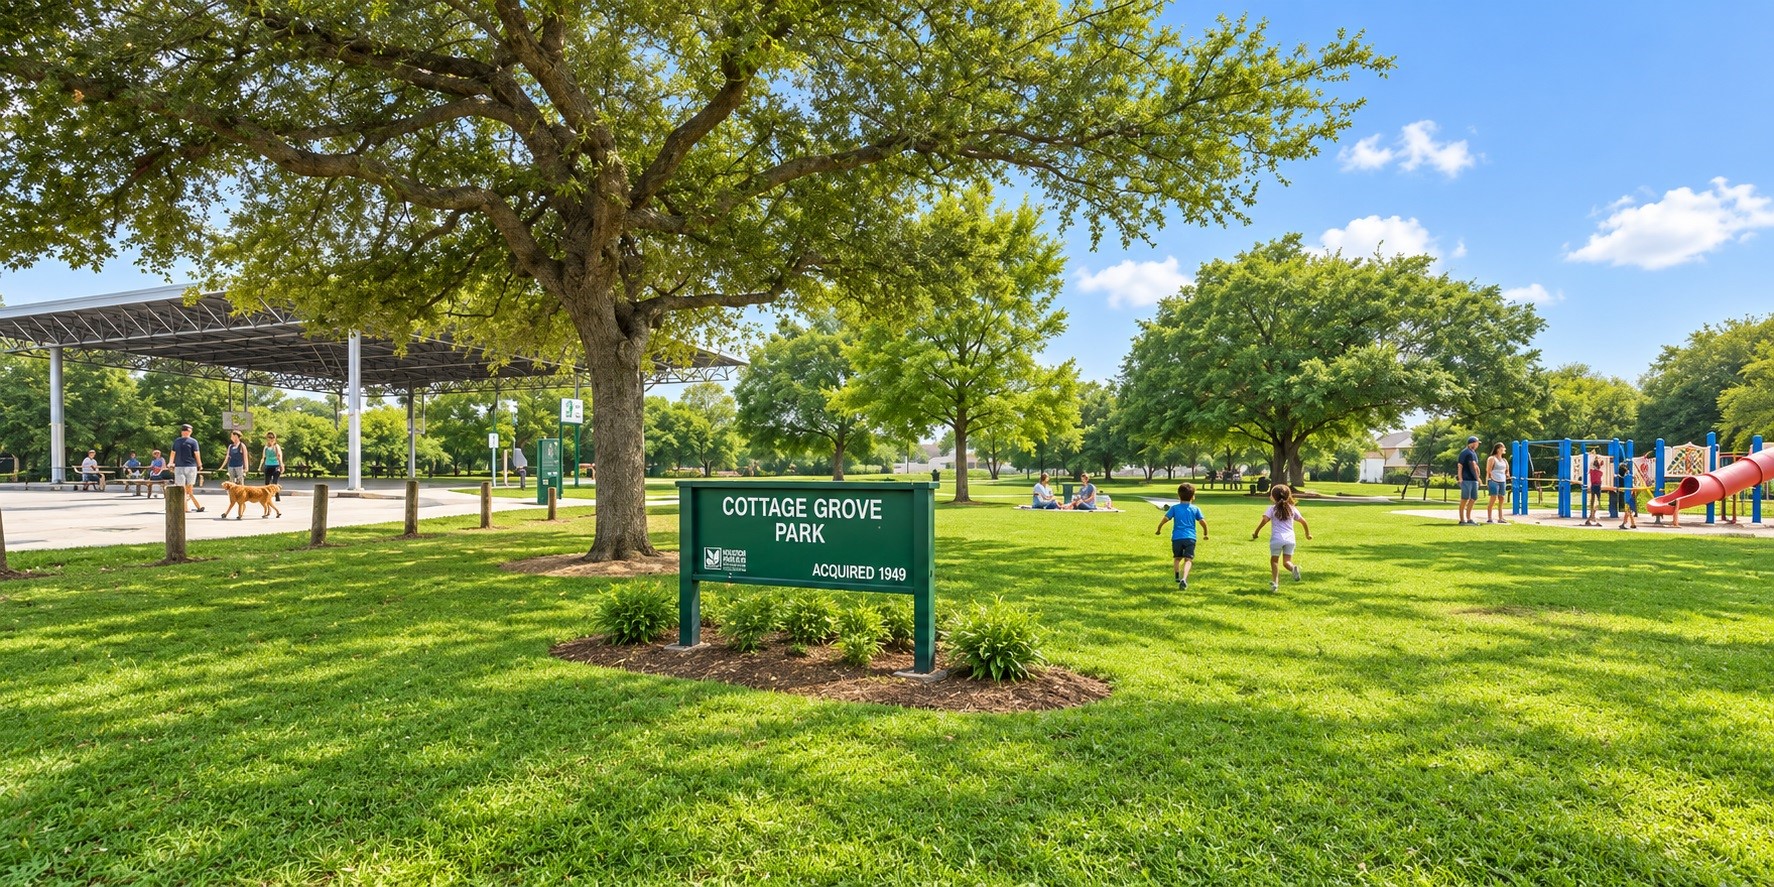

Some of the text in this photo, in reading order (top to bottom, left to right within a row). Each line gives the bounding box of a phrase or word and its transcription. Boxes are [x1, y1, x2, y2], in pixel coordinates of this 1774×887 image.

[722, 496, 883, 520] COTTAGE GROVE
[775, 522, 826, 544] PARK
[812, 563, 907, 582] ACQUIRED 1949
